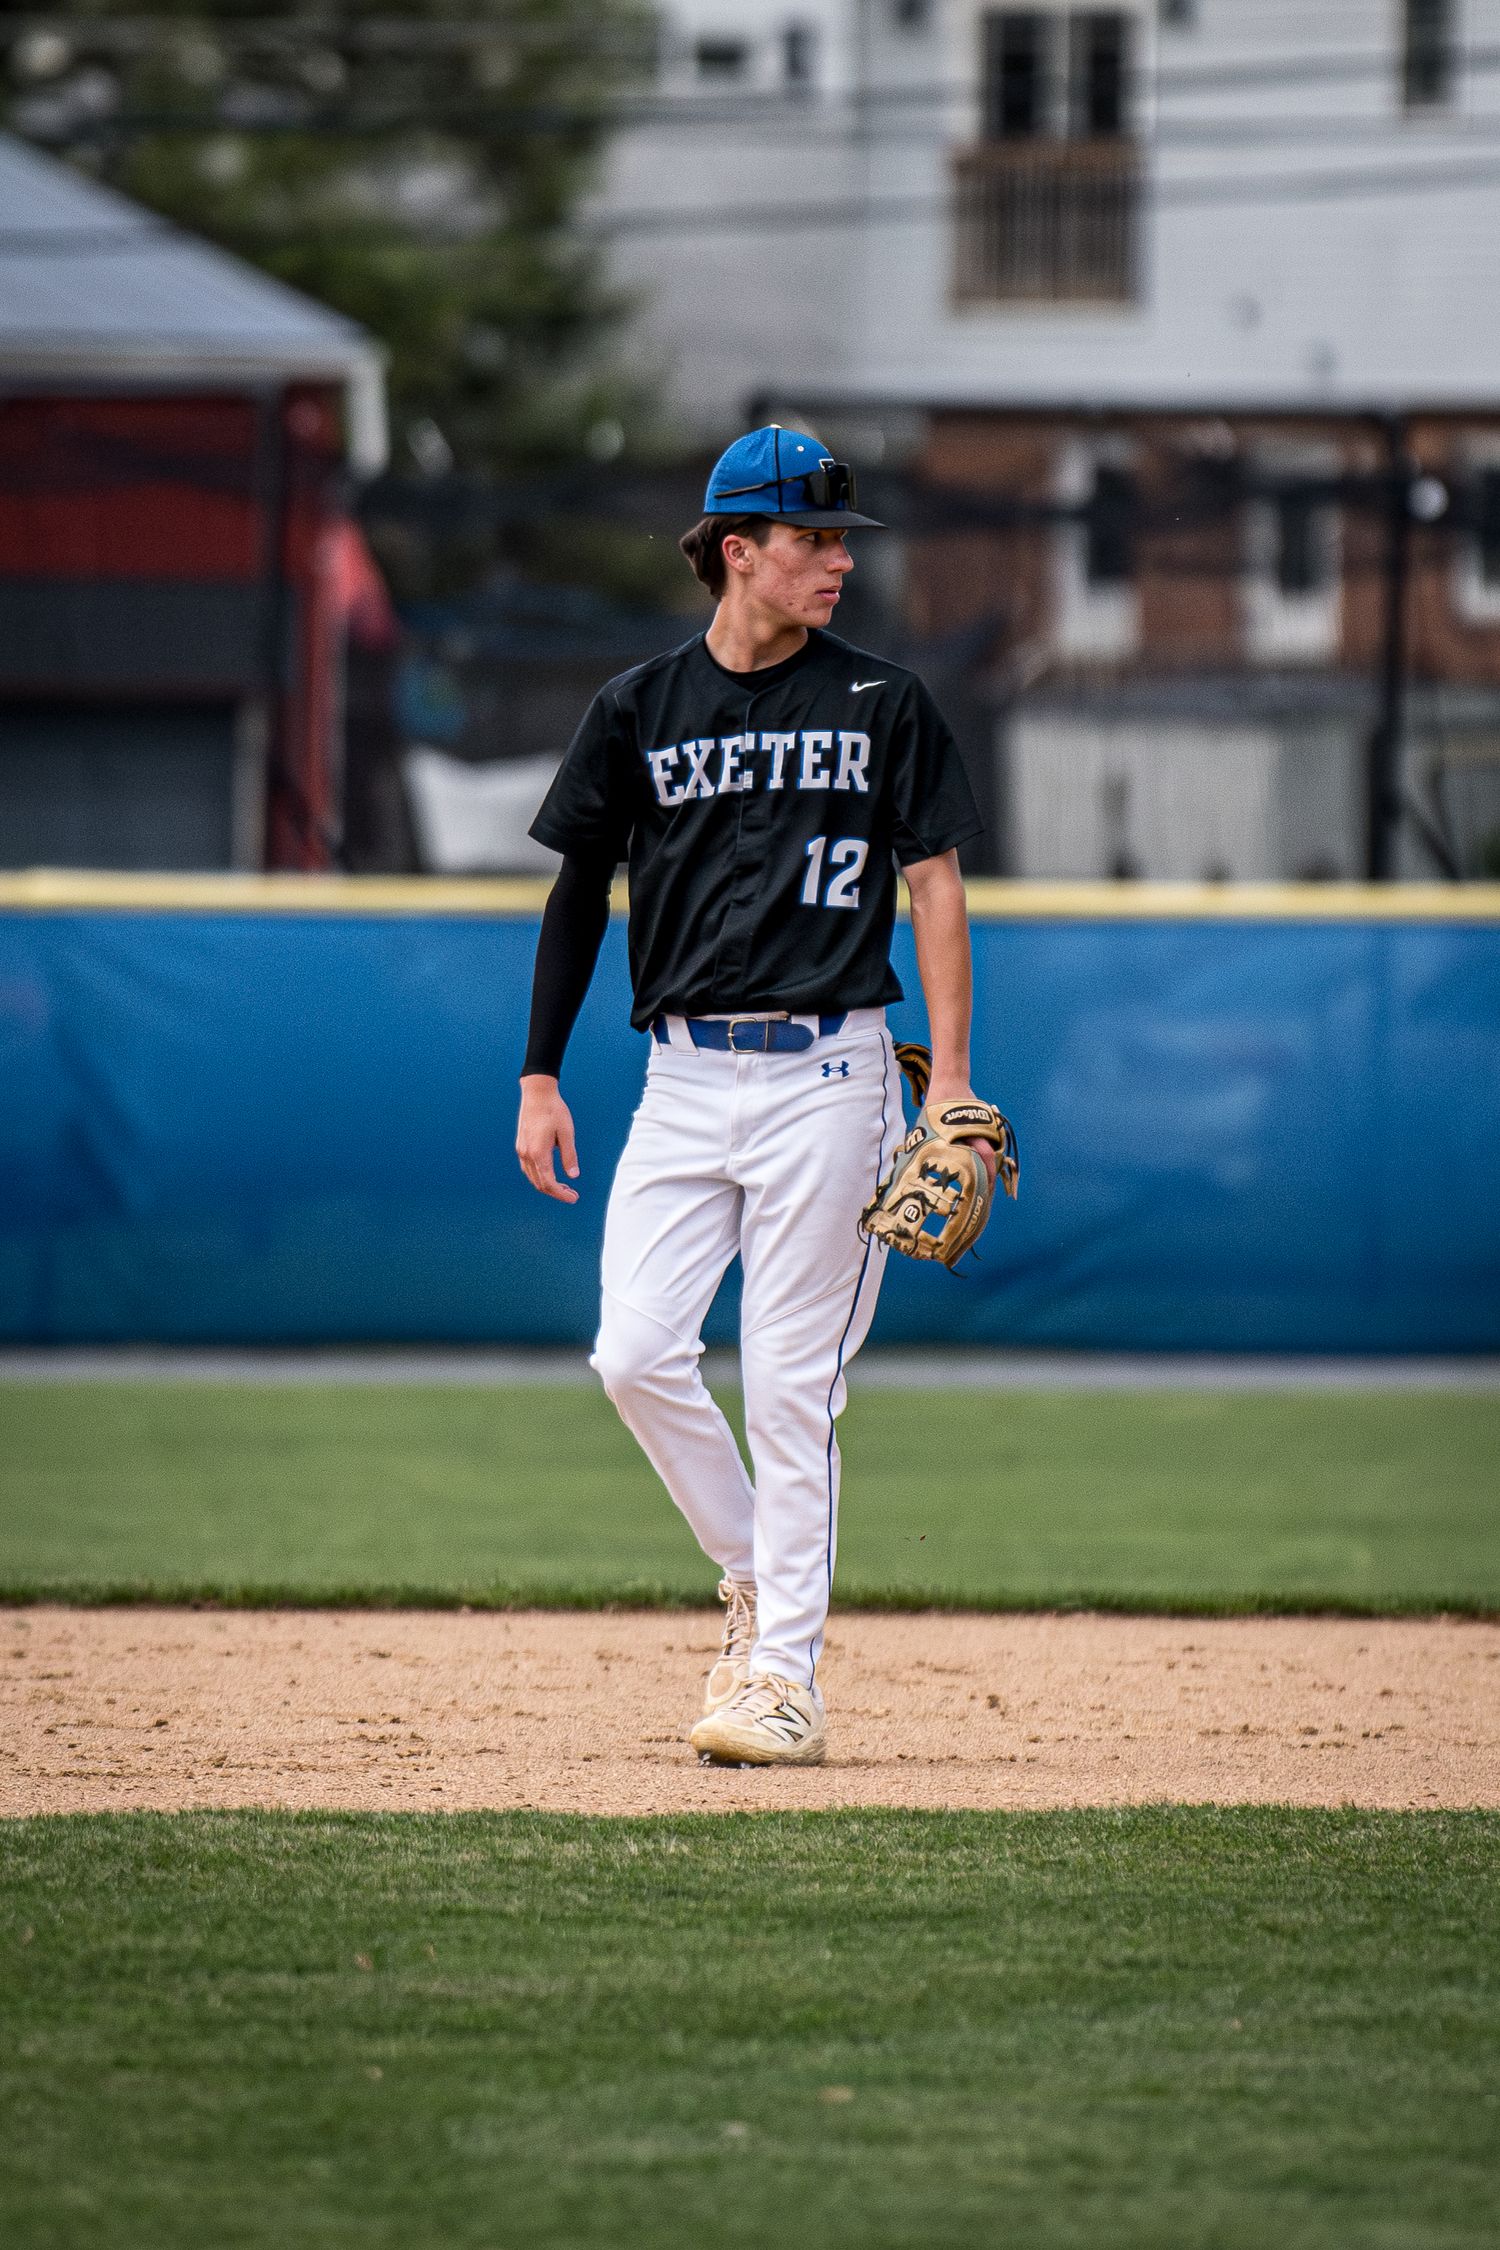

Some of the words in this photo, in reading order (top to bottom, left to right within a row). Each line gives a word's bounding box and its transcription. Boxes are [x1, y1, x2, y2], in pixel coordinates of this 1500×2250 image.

[648, 730, 871, 806] EXETER
[802, 835, 869, 908] 12
[945, 1108, 990, 1123] Wilson
